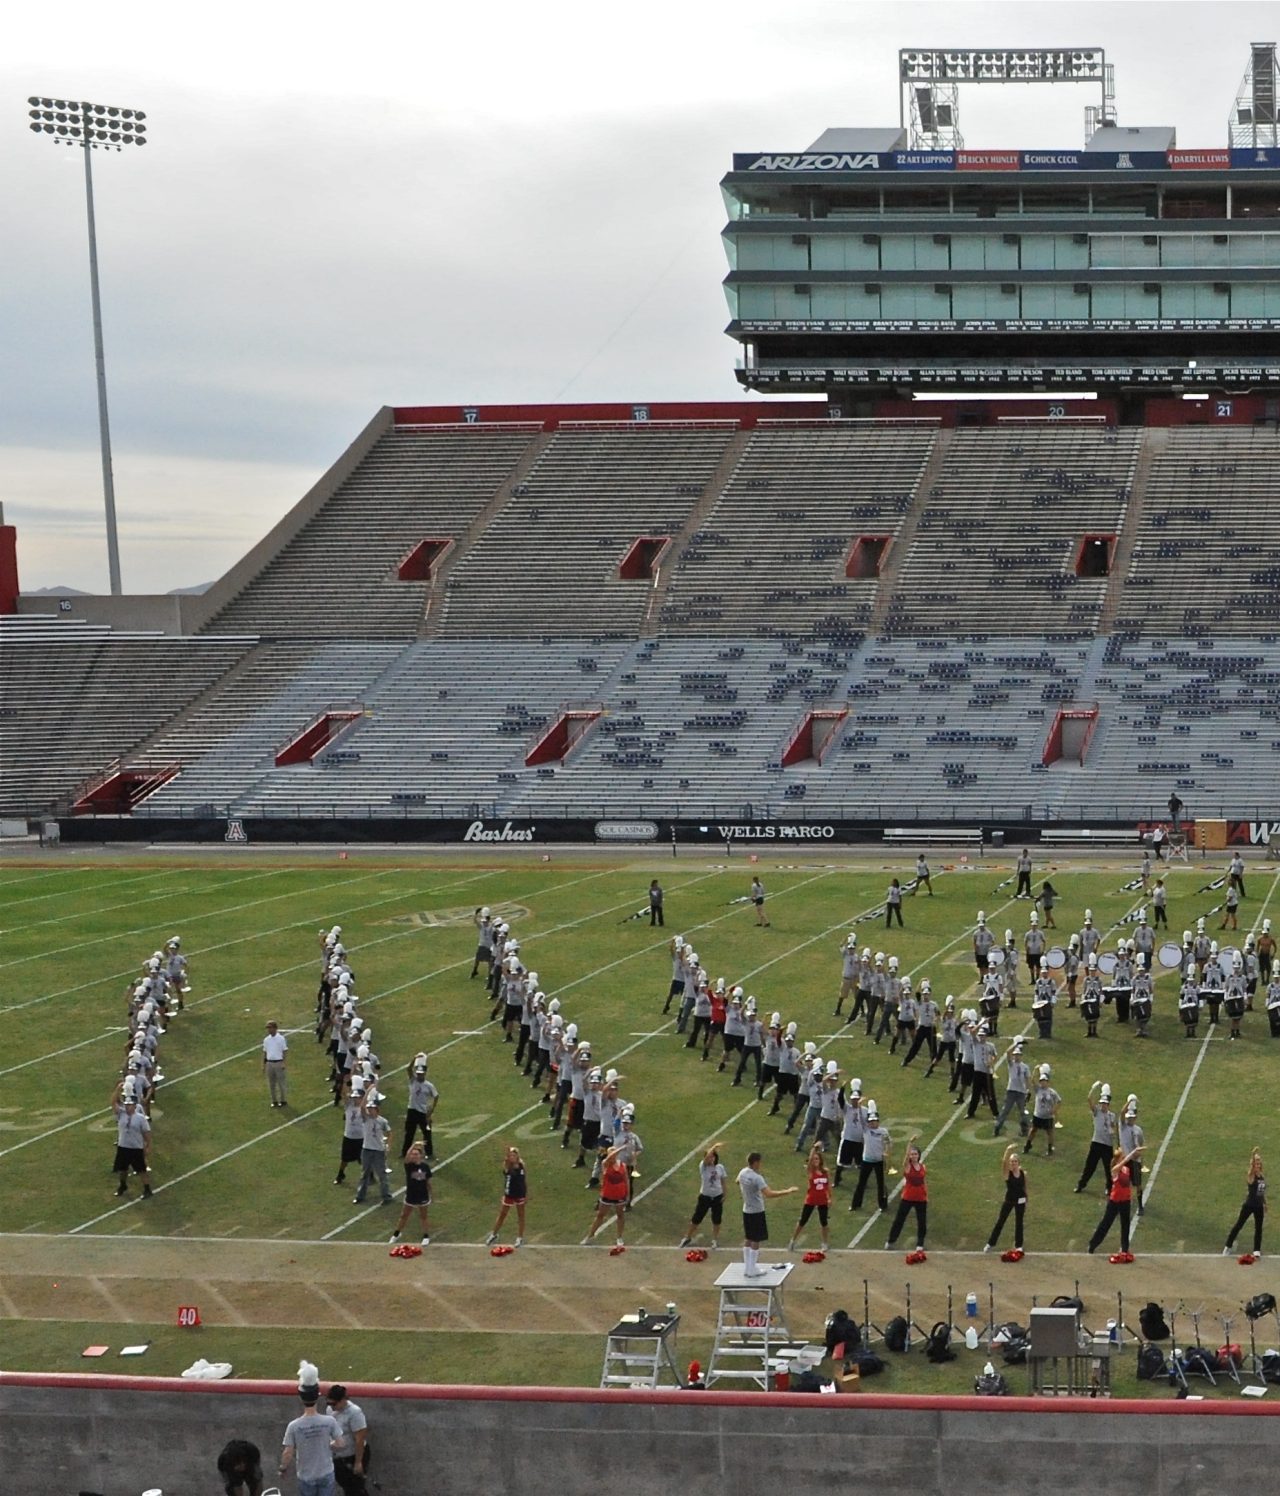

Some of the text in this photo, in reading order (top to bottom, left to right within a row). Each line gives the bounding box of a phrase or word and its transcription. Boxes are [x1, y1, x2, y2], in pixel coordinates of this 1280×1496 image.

[748, 155, 880, 170] ARIZONA
[897, 155, 953, 164] 22 ART LUPPINO
[1030, 155, 1057, 164] CHUCK
[1057, 155, 1078, 164] CECIL
[1167, 154, 1229, 163] 4 DARRYLL LEWIS
[634, 411, 647, 421] 18
[828, 408, 841, 419] 19
[1049, 407, 1064, 417] 20
[1218, 405, 1230, 416] 21
[465, 413, 476, 423] 17
[225, 820, 248, 842] A
[463, 821, 536, 841] Bashas'
[617, 826, 653, 834] CASINOS
[718, 826, 835, 838] WELLS FARGO
[179, 1308, 196, 1325] 40
[748, 1311, 766, 1327] 50
